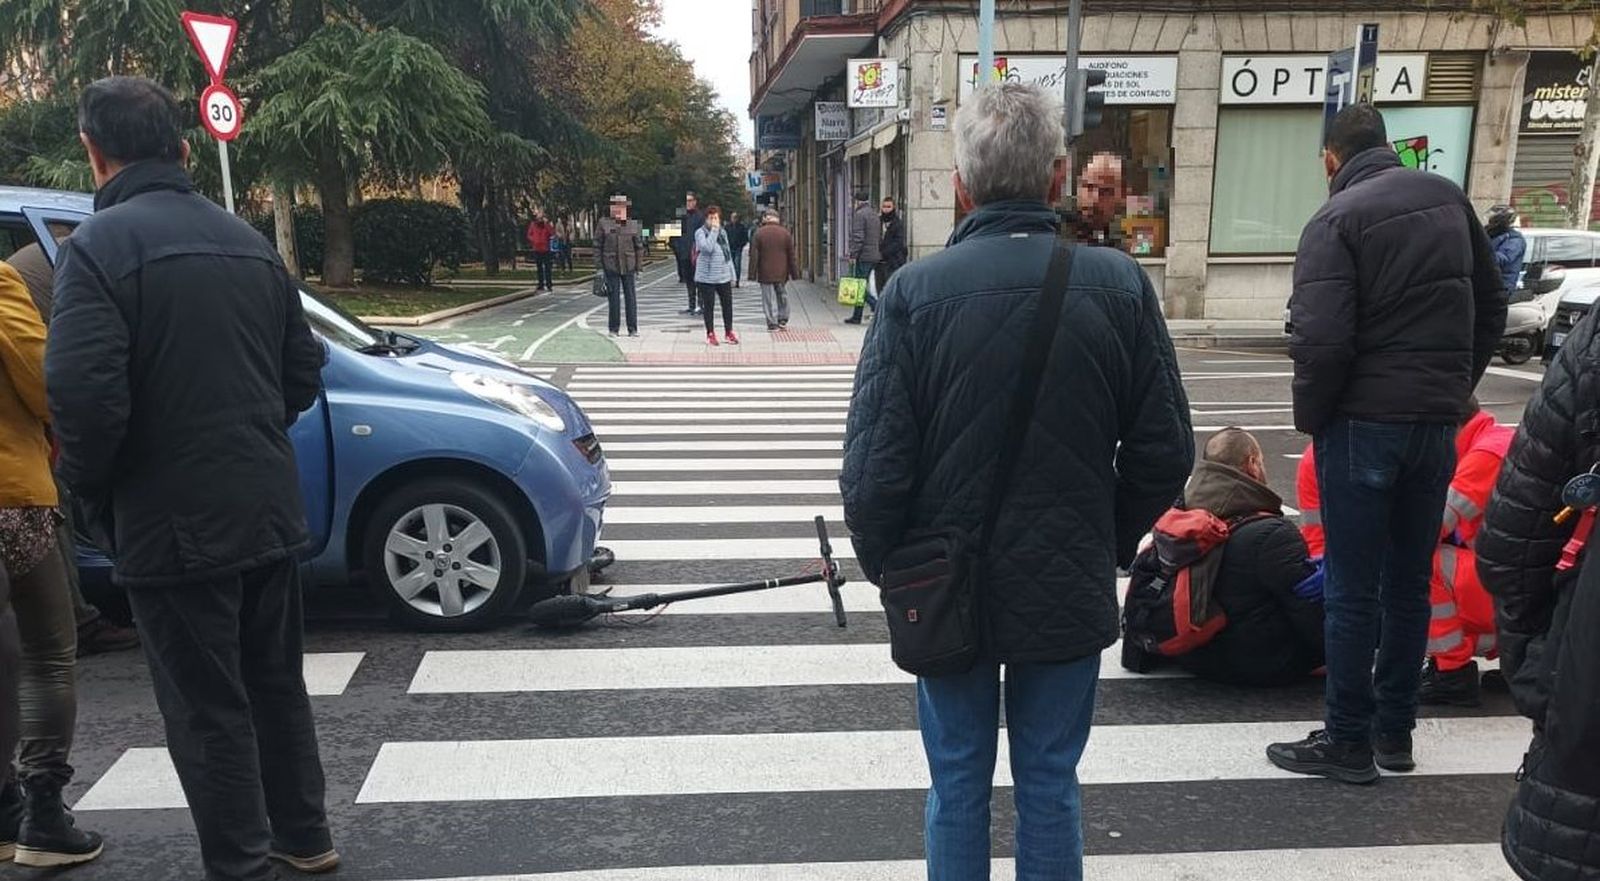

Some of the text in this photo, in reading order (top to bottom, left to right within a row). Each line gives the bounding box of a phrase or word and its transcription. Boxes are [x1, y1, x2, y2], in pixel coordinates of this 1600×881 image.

[1232, 59, 1412, 97] ÓPTA
[1129, 90, 1171, 98] CONTACTO
[1534, 83, 1589, 100] mister
[211, 103, 232, 122] 30
